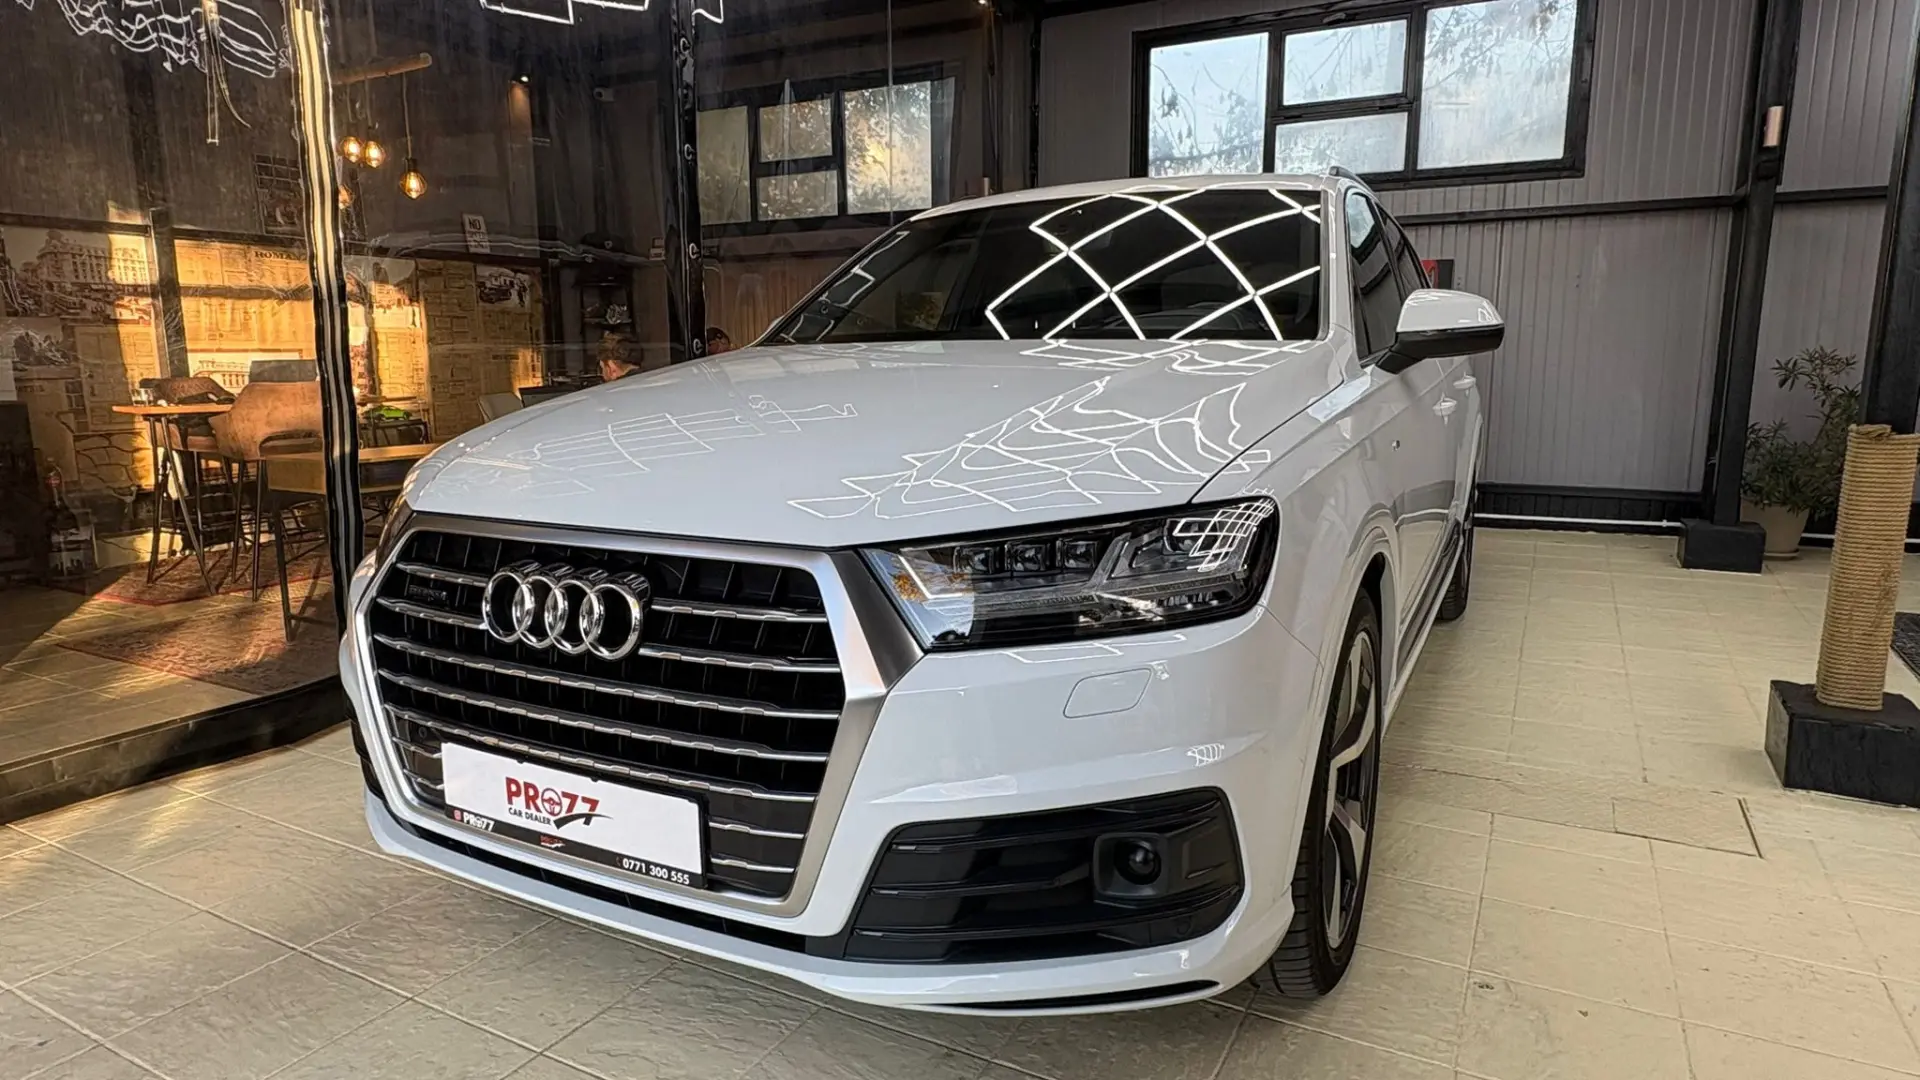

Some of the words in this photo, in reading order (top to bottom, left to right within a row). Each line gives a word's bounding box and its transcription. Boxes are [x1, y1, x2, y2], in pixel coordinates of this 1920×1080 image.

[468, 216, 482, 230] NO
[508, 807, 523, 819] CAR
[525, 812, 552, 826] DEALER
[622, 858, 646, 873] 0771
[649, 864, 669, 879] 300
[670, 871, 690, 885] 555
